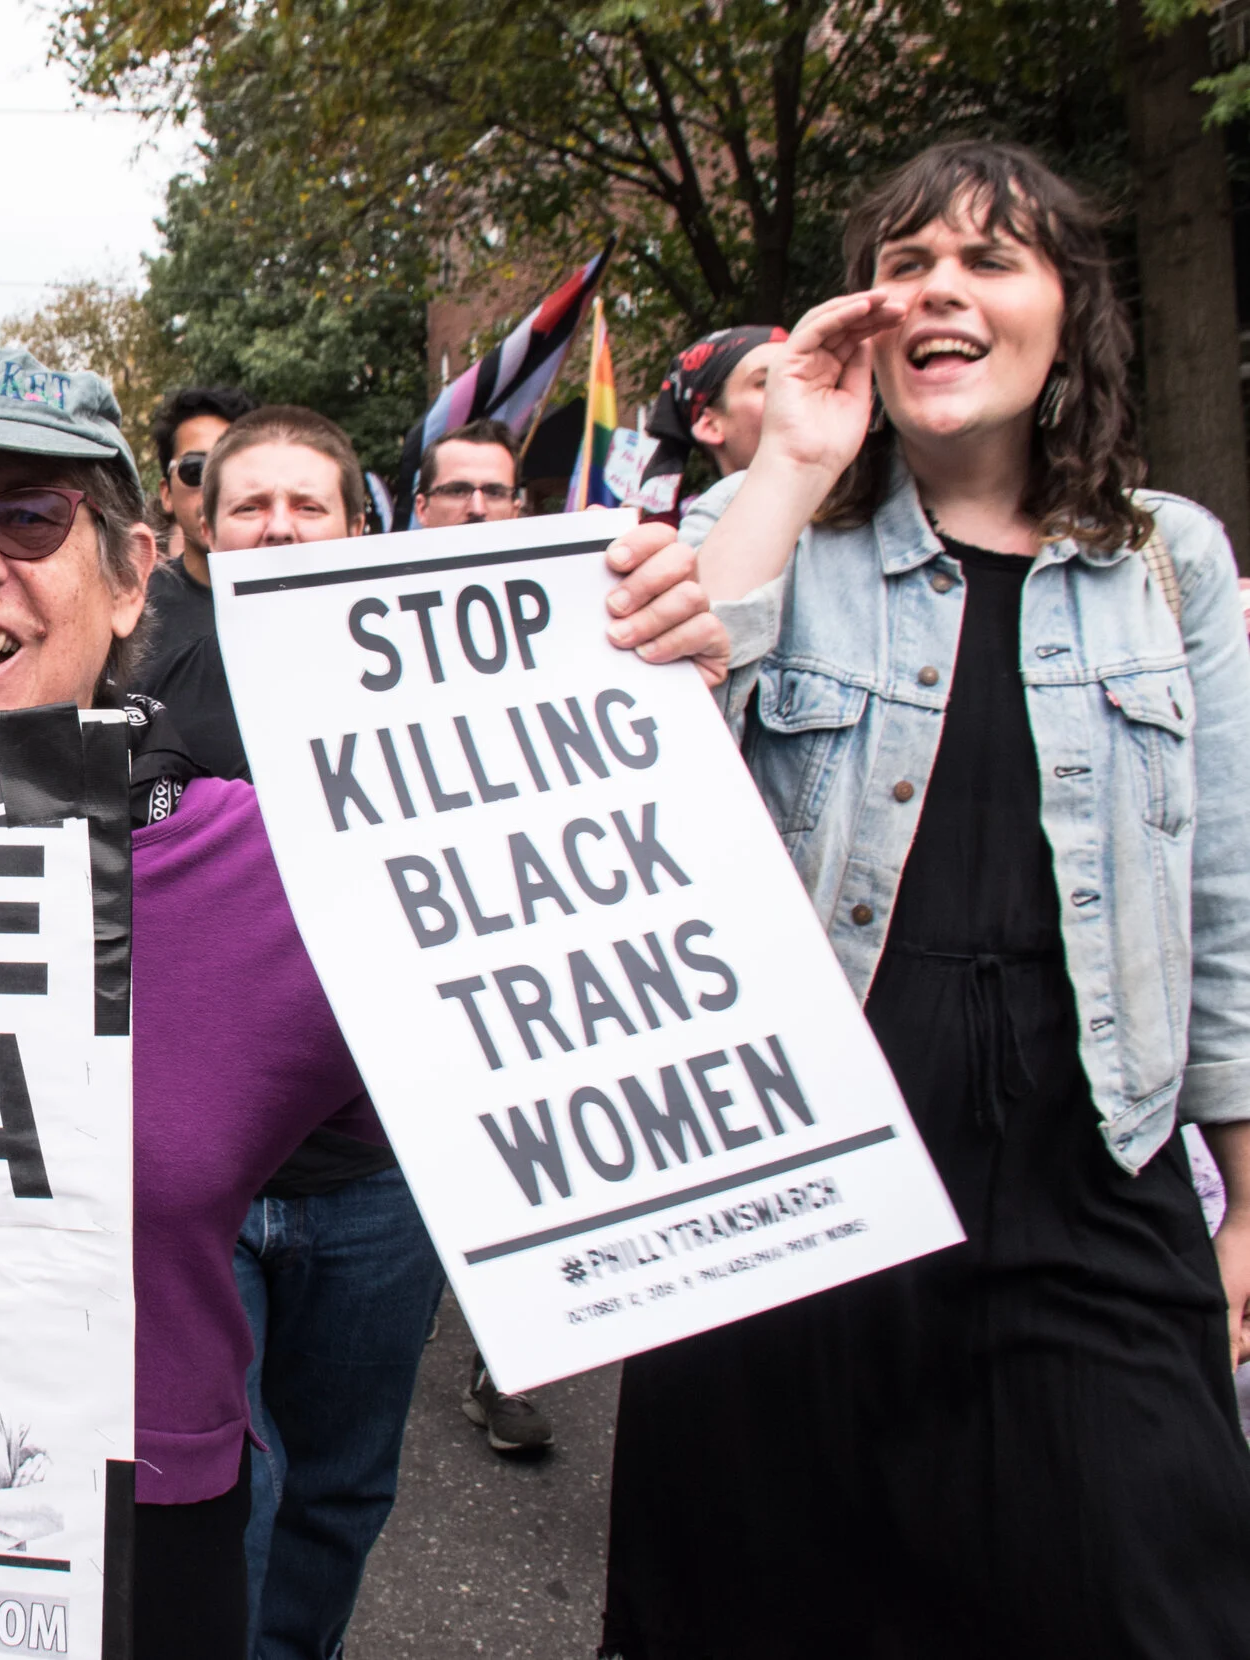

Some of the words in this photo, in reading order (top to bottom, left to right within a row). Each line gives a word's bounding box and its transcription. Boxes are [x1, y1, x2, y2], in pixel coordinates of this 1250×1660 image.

[347, 578, 551, 692] STOP
[309, 688, 659, 833] KILLING
[384, 801, 692, 949] BLACK
[435, 919, 739, 1071] TRANS
[477, 1034, 816, 1207] WOMEN
[560, 1176, 844, 1287] #PHILLYTRANSMARCH
